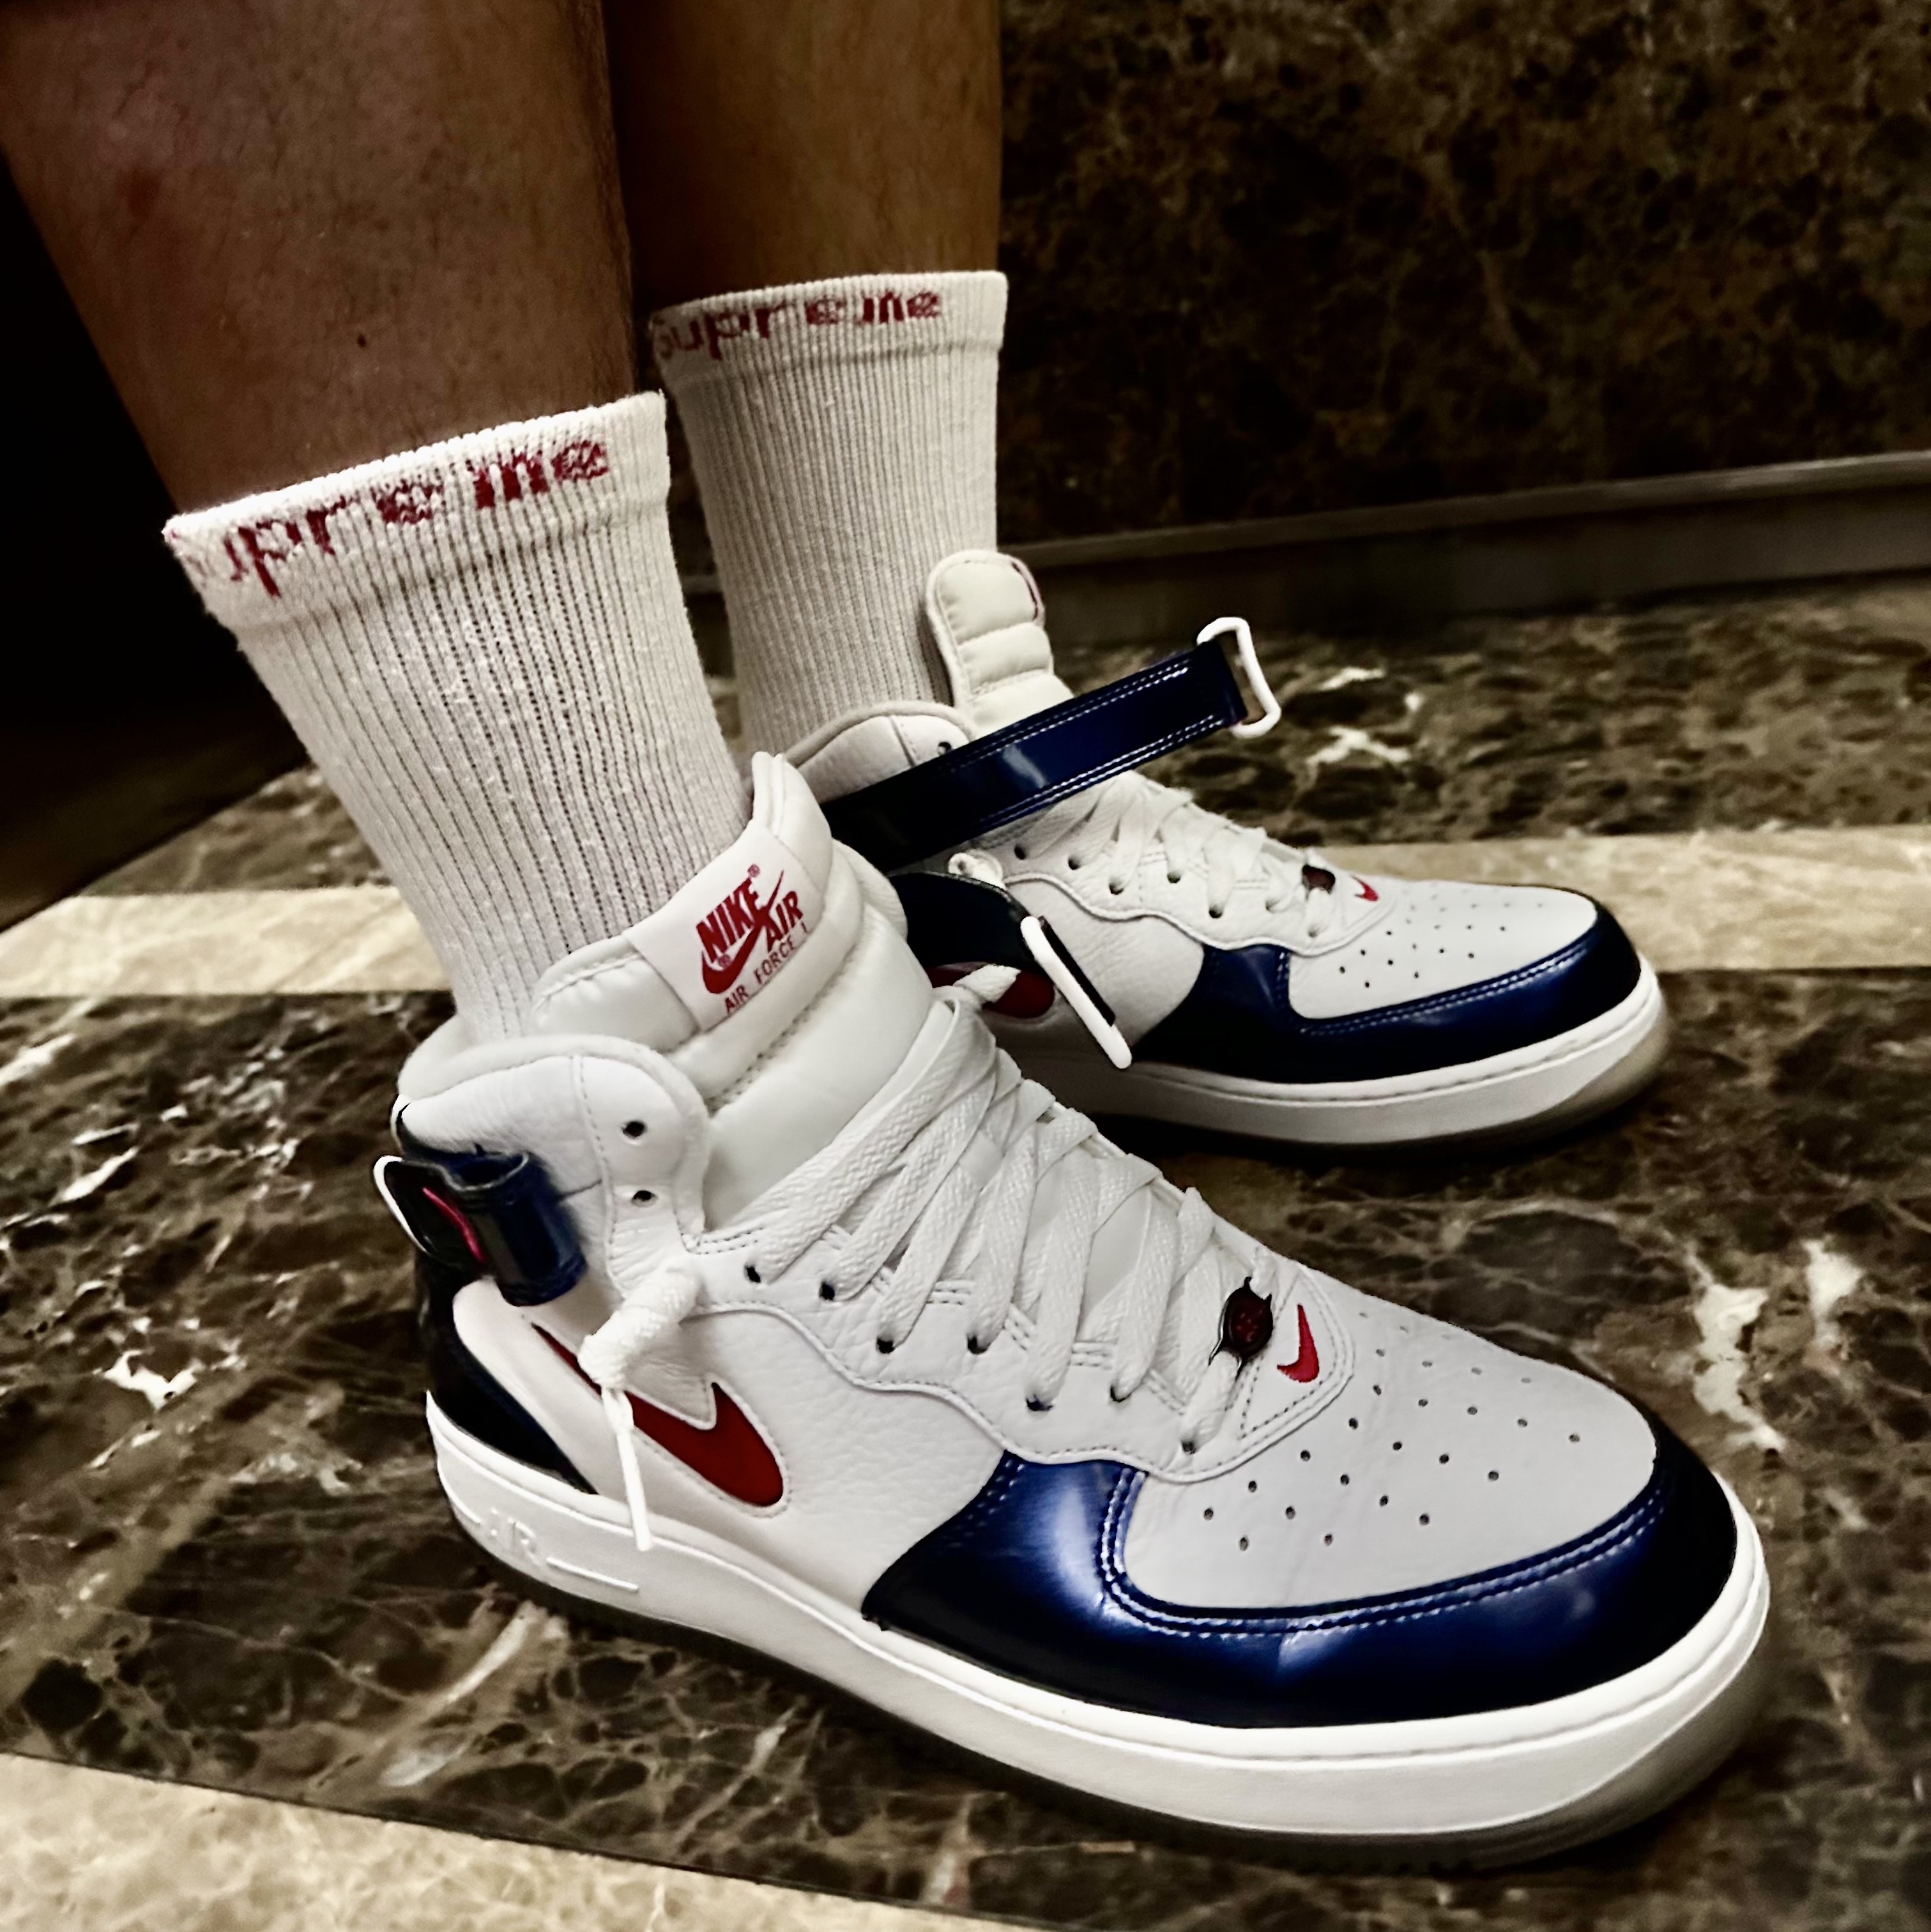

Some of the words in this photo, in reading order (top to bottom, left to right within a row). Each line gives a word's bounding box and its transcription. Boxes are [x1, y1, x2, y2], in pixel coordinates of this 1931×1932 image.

[766, 891, 803, 954] AIR
[724, 985, 749, 1014] AIR
[754, 935, 794, 984] FORCE
